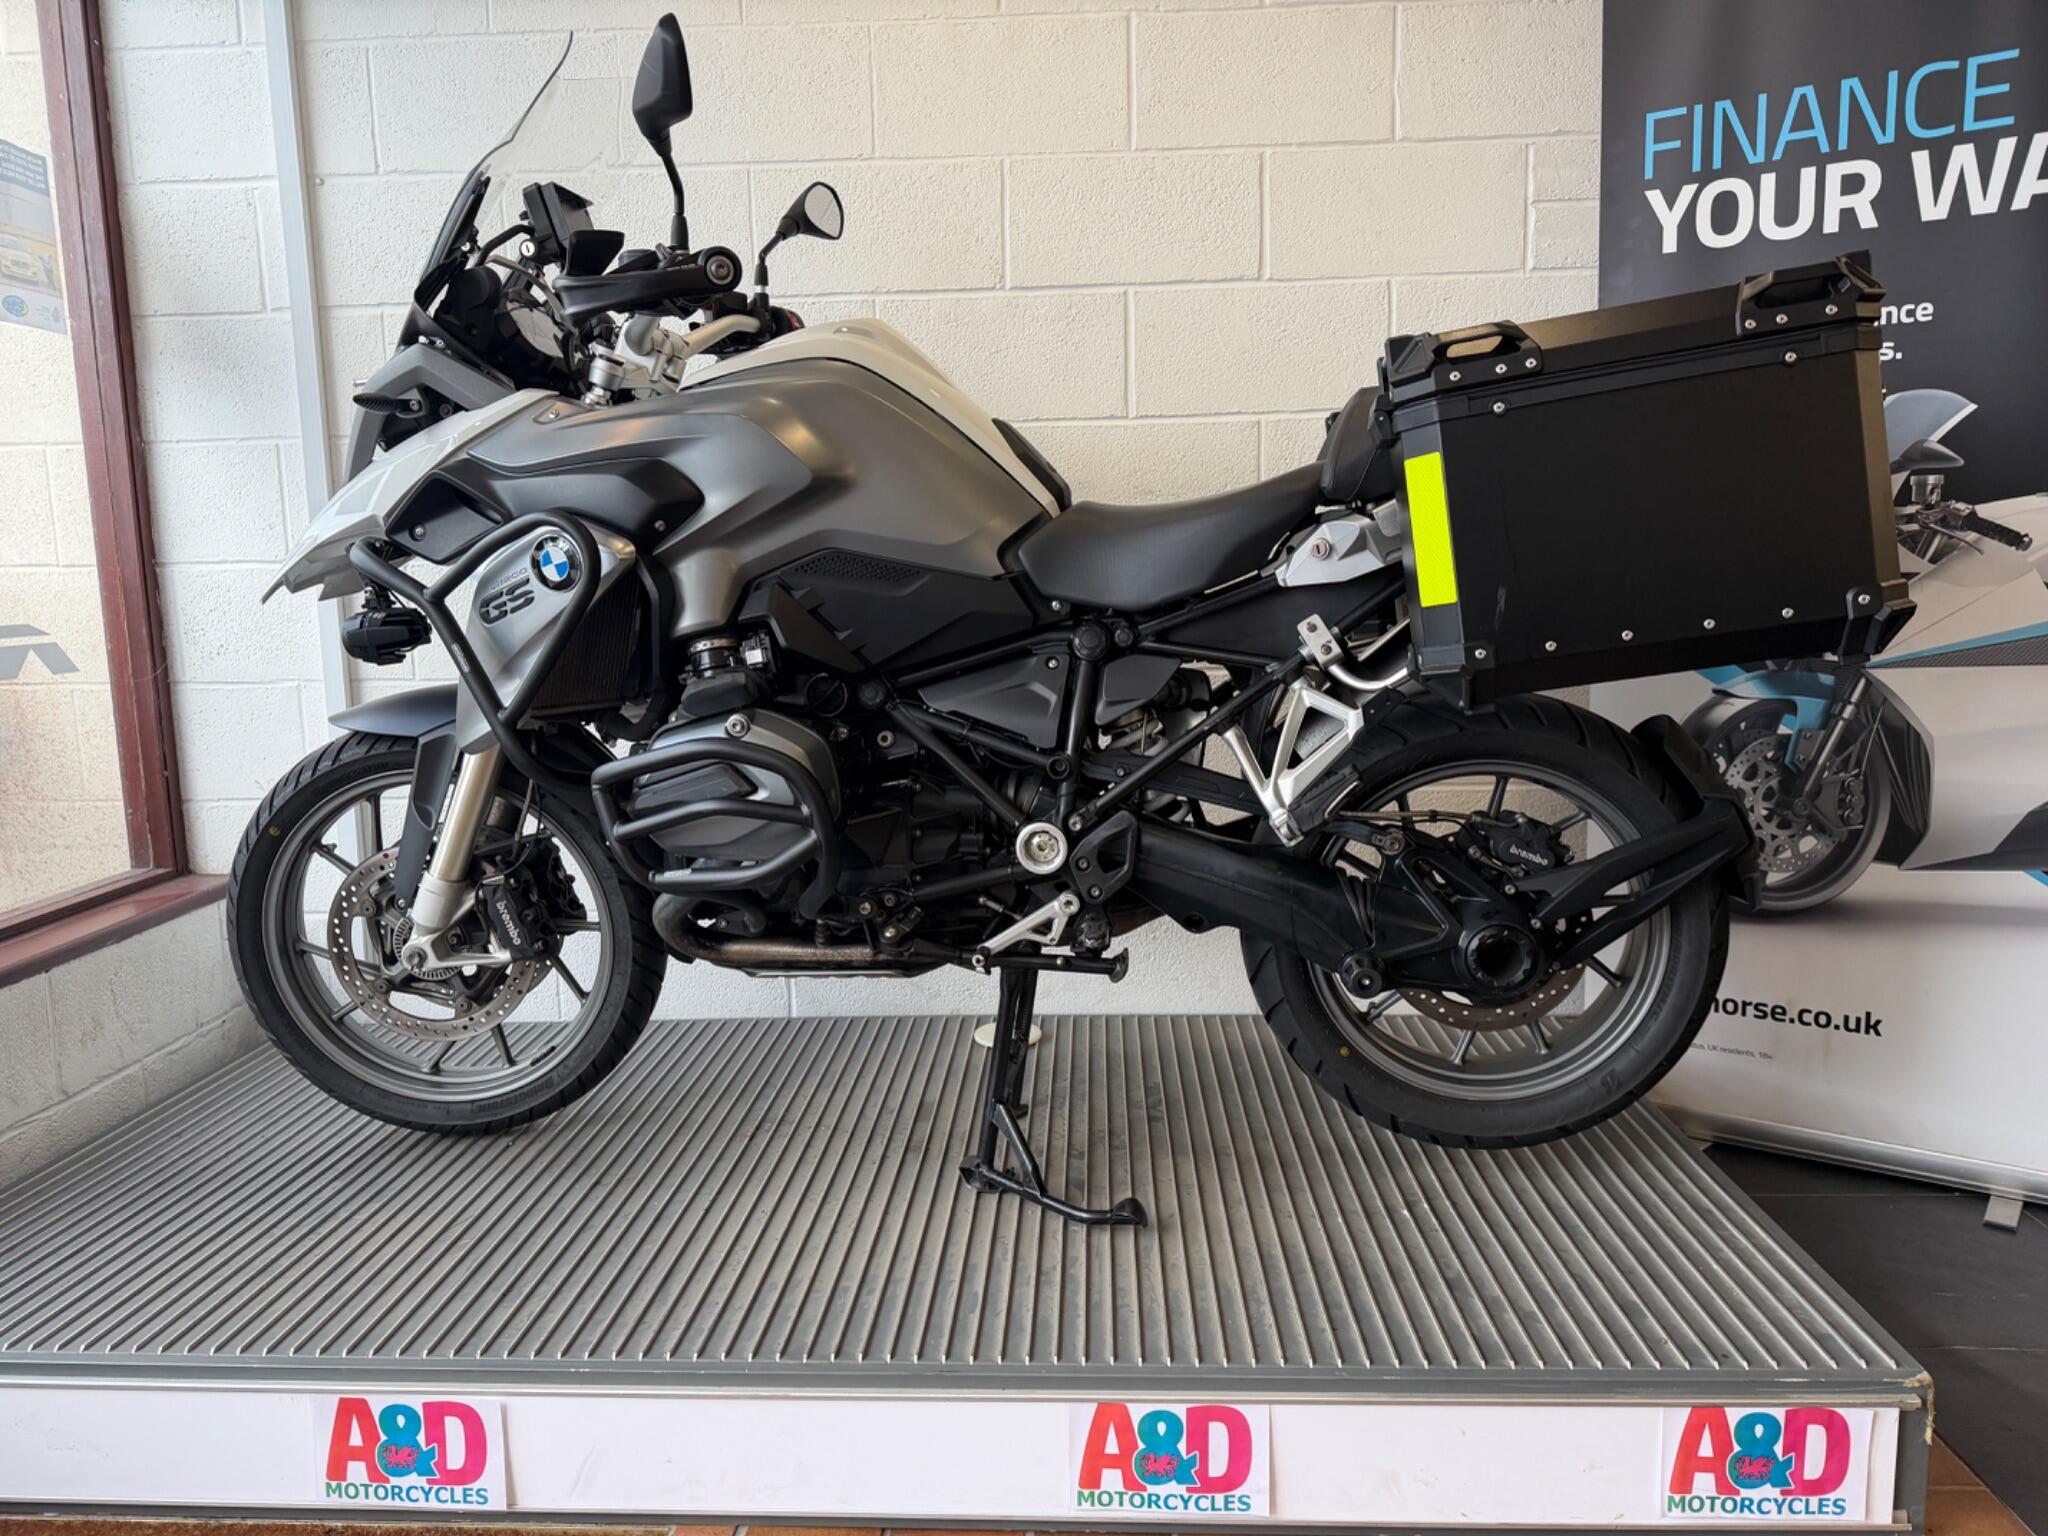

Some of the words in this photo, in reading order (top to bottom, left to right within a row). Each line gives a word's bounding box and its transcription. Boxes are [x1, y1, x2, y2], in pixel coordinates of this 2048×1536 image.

[1645, 48, 2020, 180] FINANCE
[1644, 159, 1882, 254] YOUR
[1873, 302, 1934, 327] nce
[479, 576, 536, 625] GS
[1509, 844, 1549, 866] brembo
[496, 900, 521, 946] brembo
[326, 1397, 487, 1486] A&D
[1078, 1401, 1253, 1494] A&D
[1669, 1405, 1850, 1497] A&D
[325, 1481, 489, 1505] MOTORCYCLES
[1076, 1490, 1251, 1512] MOTORCYCLES
[1667, 1495, 1846, 1515] MOTORCYCLES
